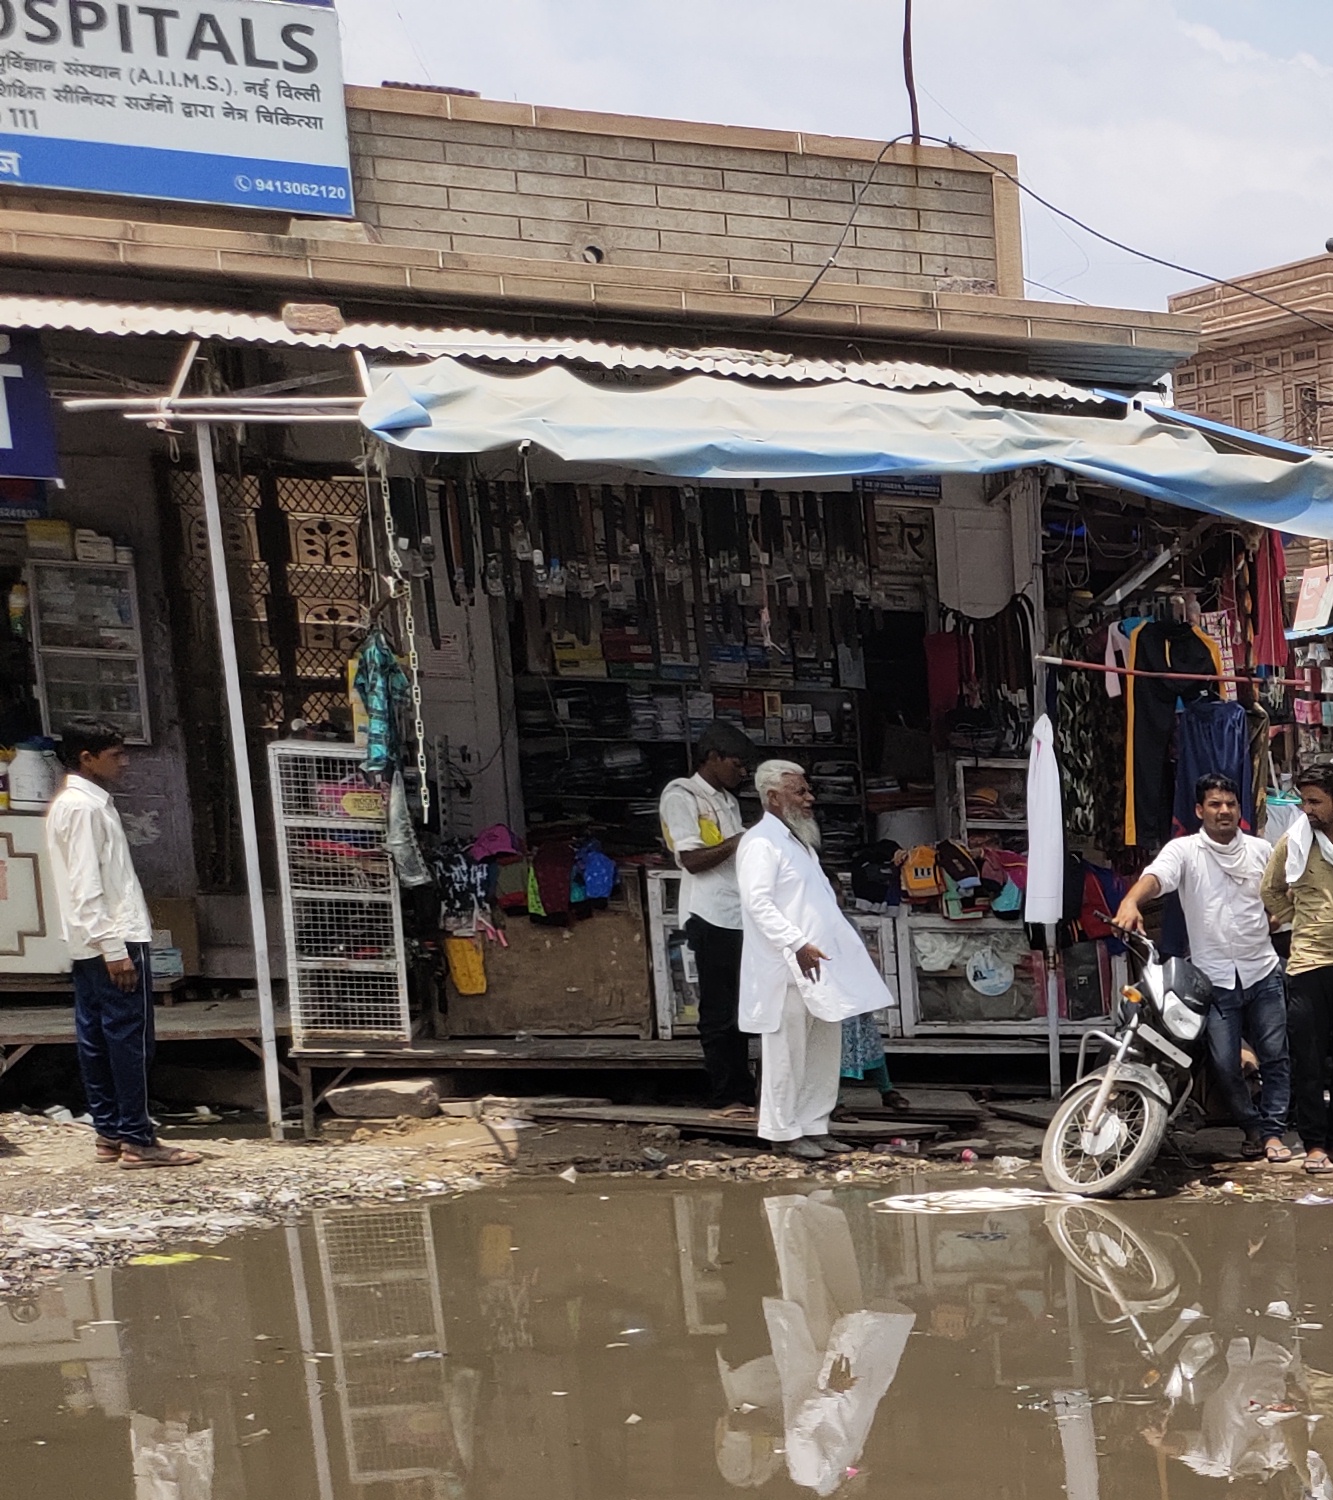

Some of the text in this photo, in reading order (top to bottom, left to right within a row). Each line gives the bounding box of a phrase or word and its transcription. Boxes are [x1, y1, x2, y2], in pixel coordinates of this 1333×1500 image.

[64, 57, 122, 81] संस्थान
[243, 78, 270, 99] नई
[277, 79, 322, 102] दिल्ली
[53, 84, 117, 108] सीनियर
[124, 94, 174, 114] सर्जनों
[181, 102, 216, 120] द्वारा
[222, 102, 248, 121] नेत्र
[256, 106, 324, 130] चिकित्सा
[255, 179, 346, 200] 9413062120
